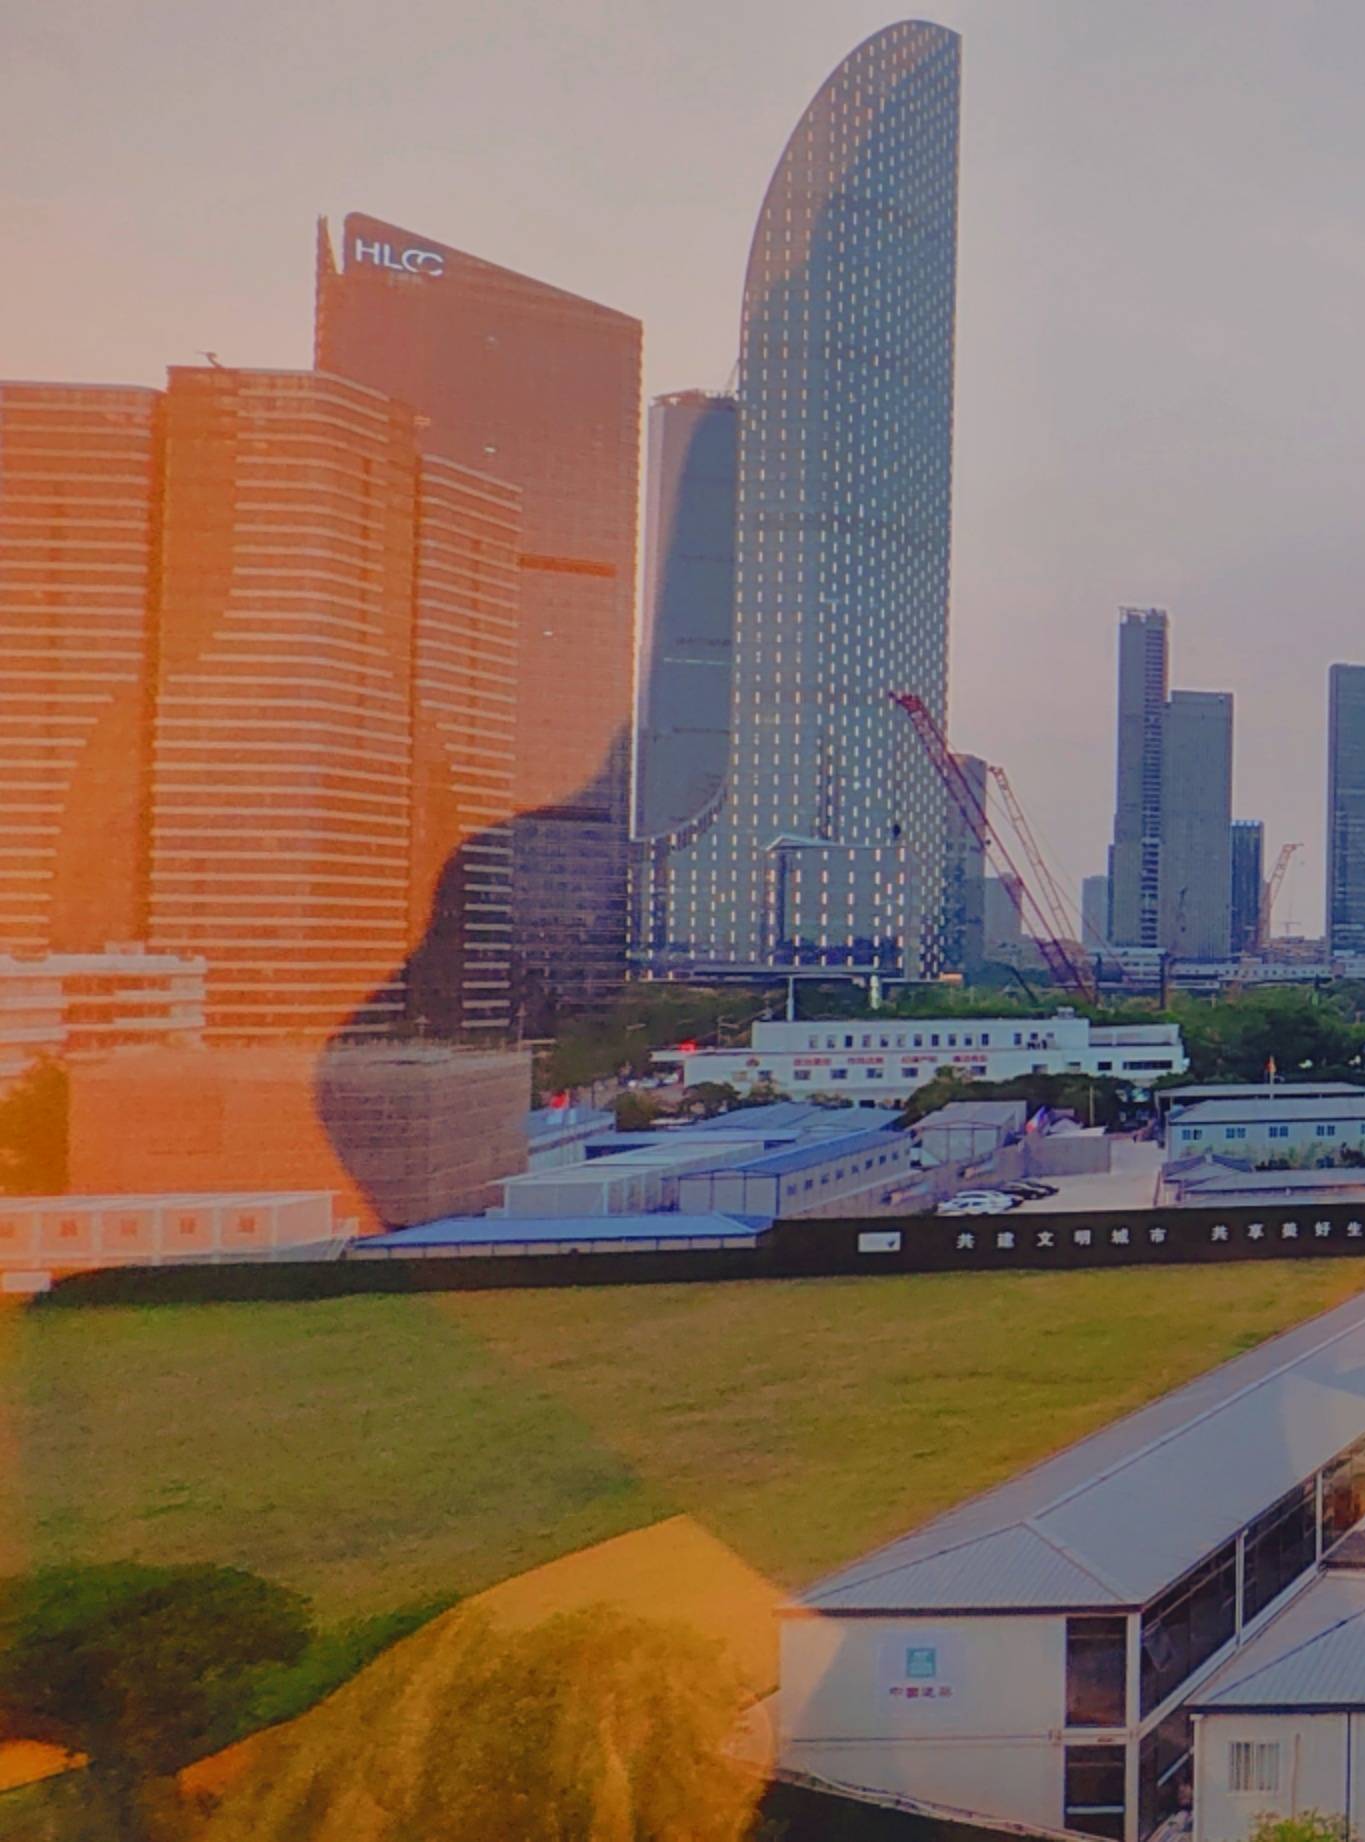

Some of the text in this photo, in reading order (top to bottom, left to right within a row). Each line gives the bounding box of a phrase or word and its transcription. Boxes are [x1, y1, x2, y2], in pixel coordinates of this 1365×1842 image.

[956, 1226, 1168, 1250] 共建文明城市
